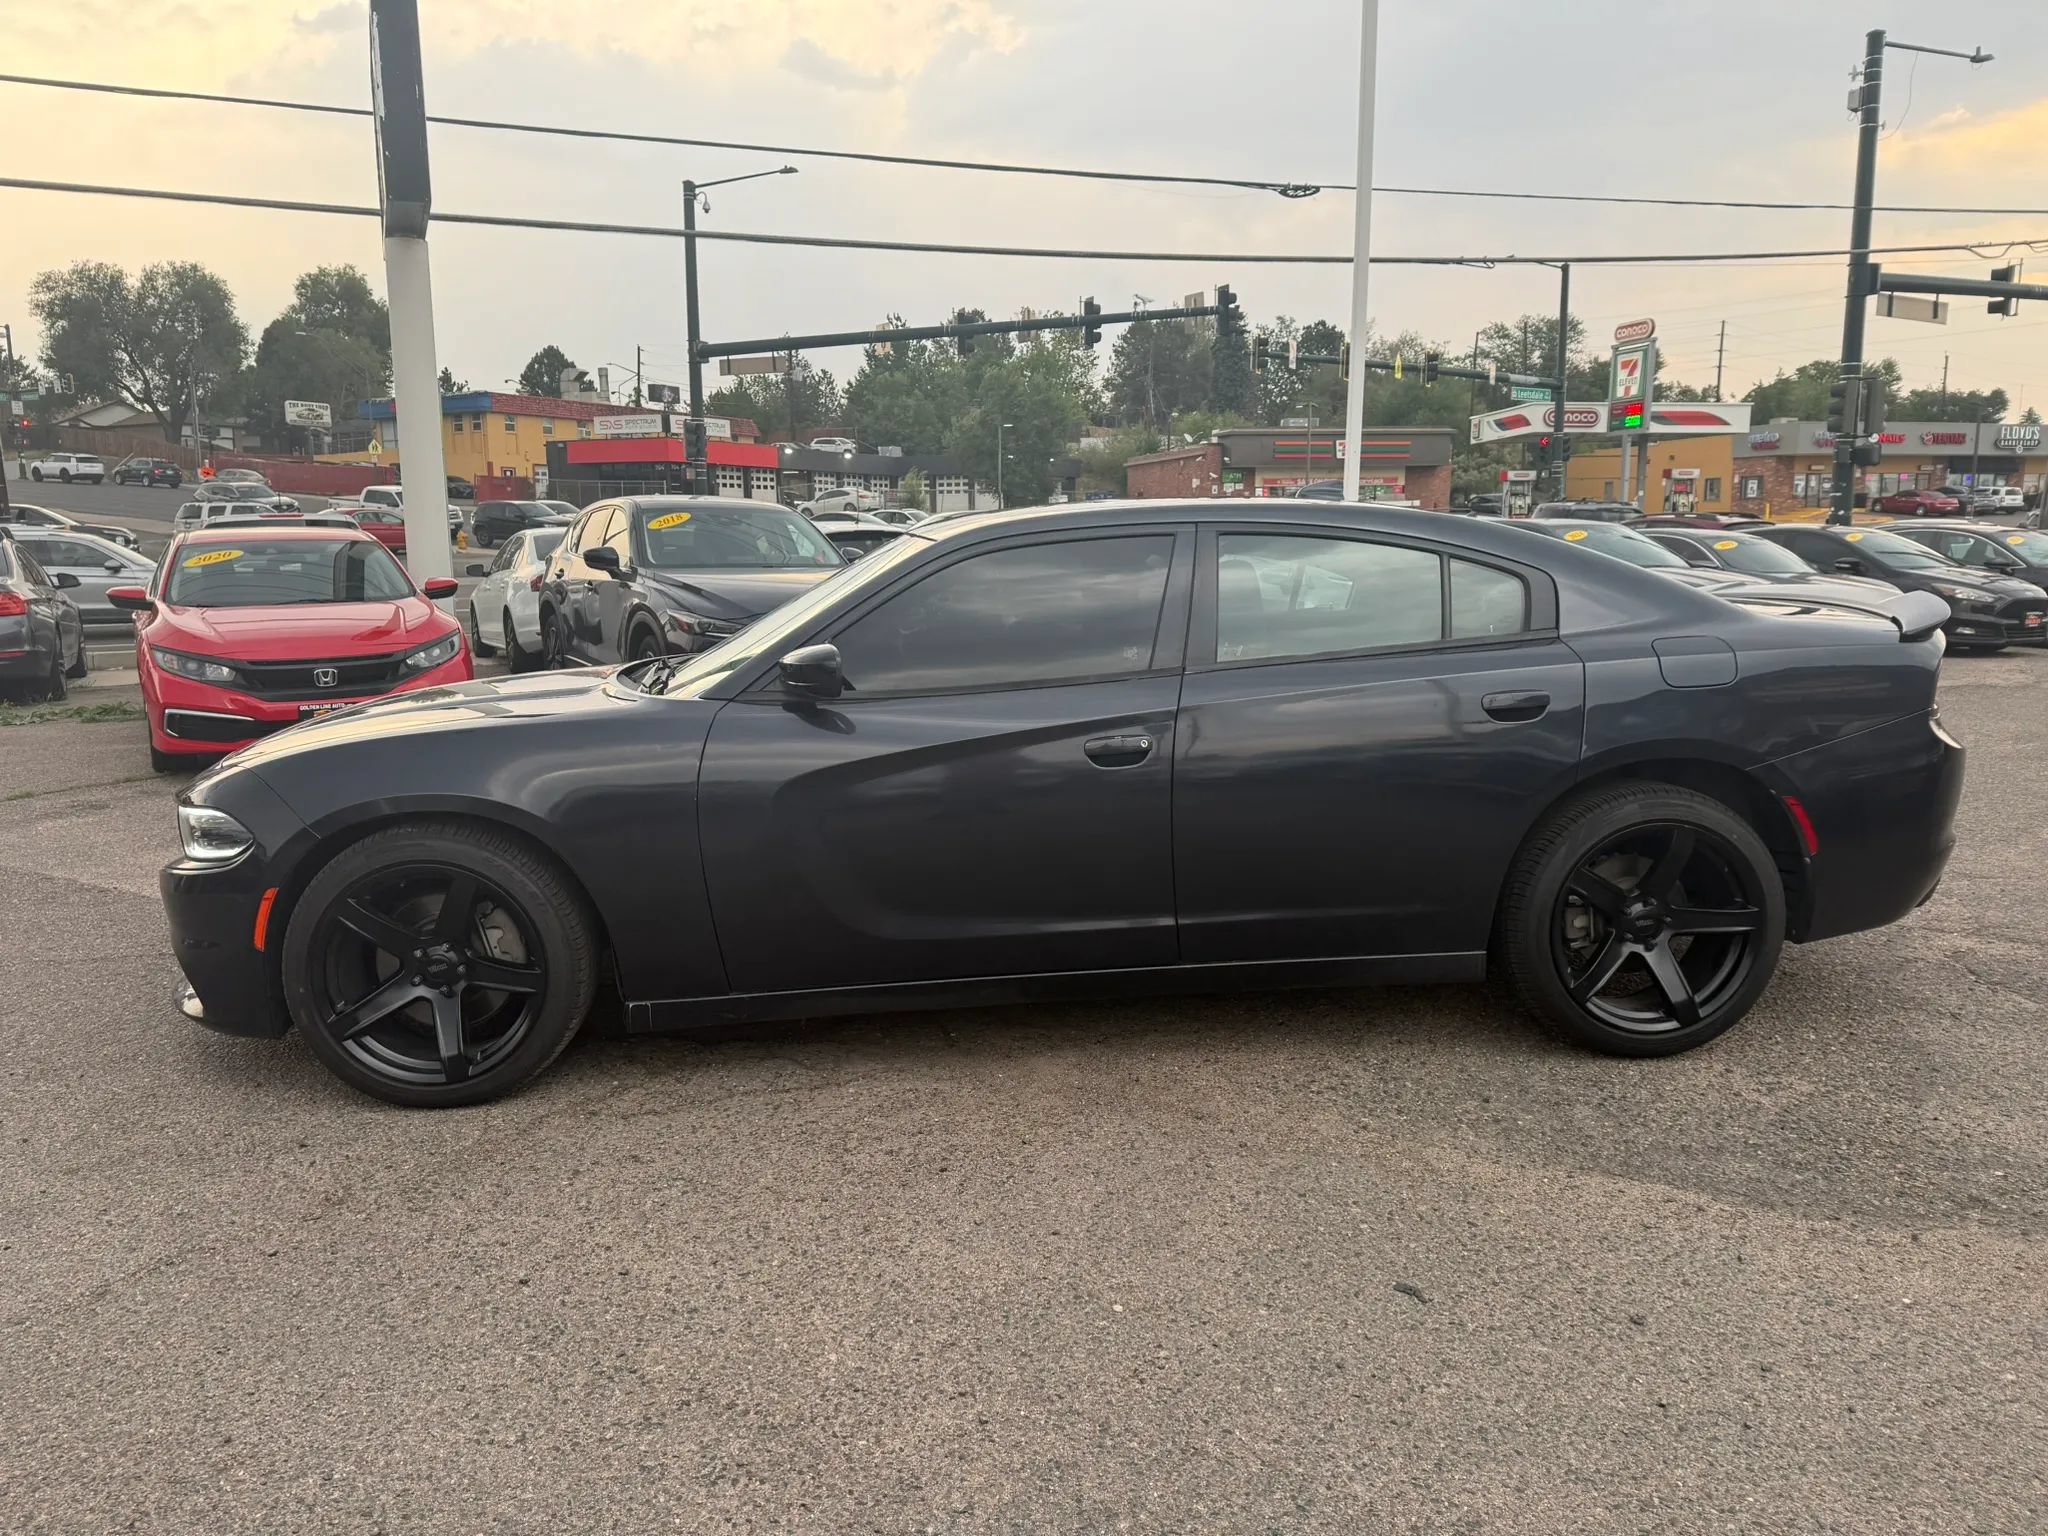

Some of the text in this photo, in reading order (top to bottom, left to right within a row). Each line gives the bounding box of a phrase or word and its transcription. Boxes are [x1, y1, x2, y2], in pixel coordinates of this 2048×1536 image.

[1517, 390, 1543, 400] Leetsdale
[2001, 426, 2040, 439] FLOYD'S
[656, 514, 683, 527] 2018
[193, 551, 232, 565] 2020
